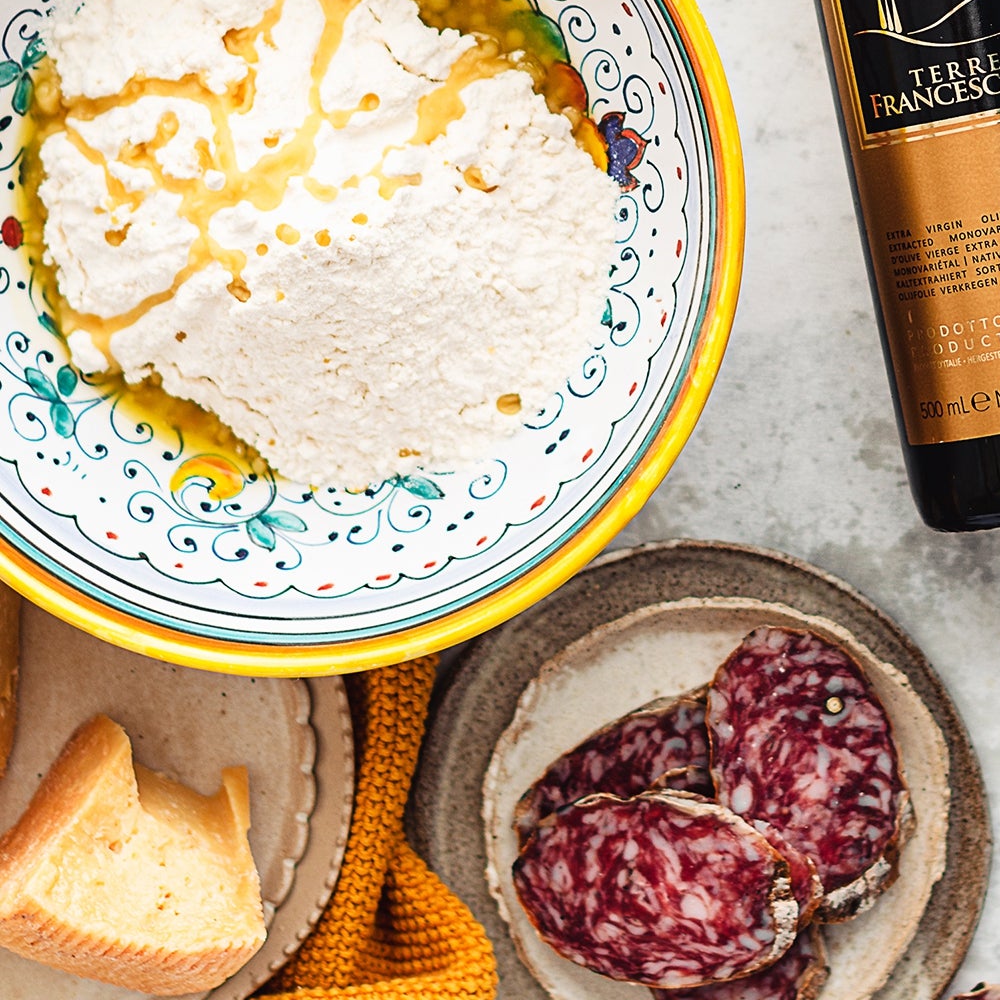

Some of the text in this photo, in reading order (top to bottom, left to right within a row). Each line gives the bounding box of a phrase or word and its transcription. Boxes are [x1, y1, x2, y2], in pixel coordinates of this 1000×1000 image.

[886, 229, 912, 240] EXTRA
[925, 220, 963, 233] VIRGIN
[888, 238, 934, 253] EXTRACTED
[891, 252, 921, 264] D'OLIVE
[925, 246, 960, 259] VIERGE
[965, 239, 998, 252] EXTRA
[894, 258, 960, 277] MONOVARIÉTAL
[896, 270, 967, 289] KALTEXTRAHIERT
[940, 277, 998, 295] VERKREGEN
[920, 401, 943, 419] 500
[947, 397, 970, 416] mL
